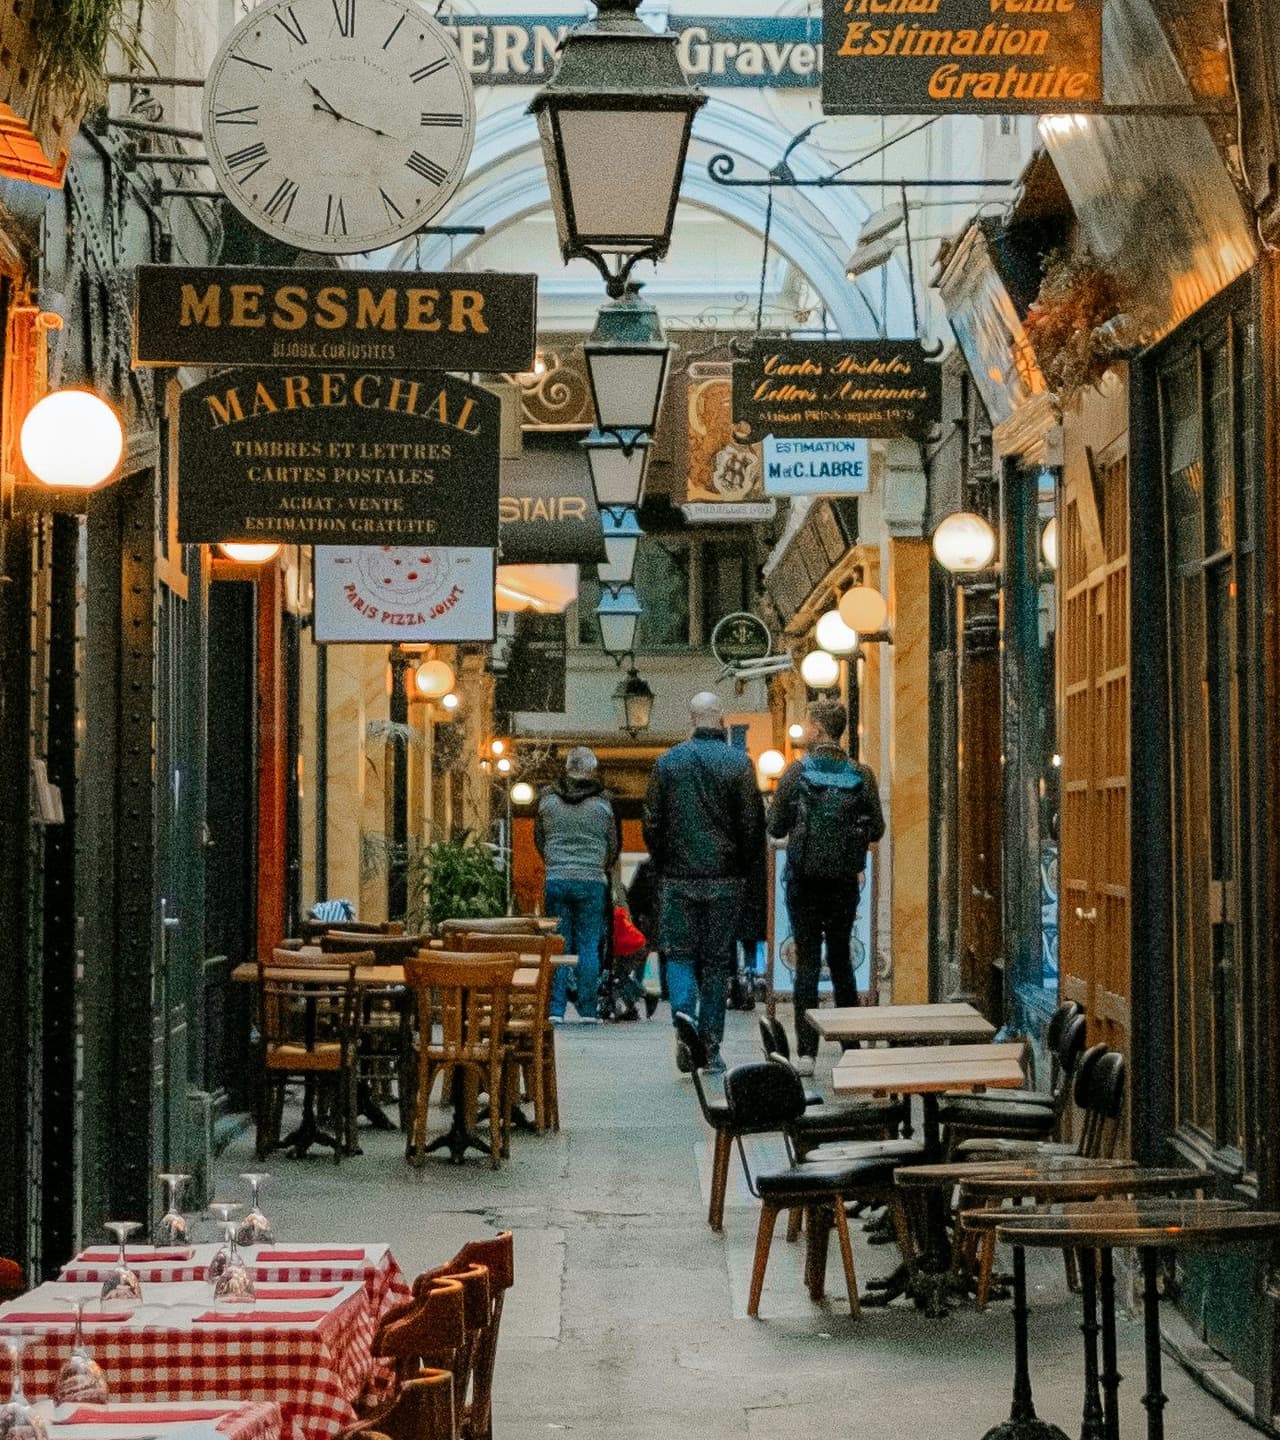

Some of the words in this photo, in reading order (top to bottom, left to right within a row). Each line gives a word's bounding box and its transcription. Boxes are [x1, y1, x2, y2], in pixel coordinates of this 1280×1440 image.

[836, 20, 1051, 57] Estimation
[926, 62, 1092, 101] Gratuite
[179, 283, 490, 334] MESSMER
[205, 372, 483, 438] MARECHAL
[231, 440, 322, 458] TIMBRES
[326, 441, 356, 458] ET
[359, 441, 453, 459] LETTRES
[775, 441, 857, 454] ESTIMATION
[247, 466, 327, 484] CARTES
[334, 466, 436, 486] POSTALES
[278, 496, 334, 511] ACHAT
[347, 496, 405, 512] VENTE
[244, 516, 347, 533] ESTIMATION
[351, 517, 437, 534] GRATUITE
[343, 581, 379, 622] PARIS
[380, 610, 427, 627] PIZZA
[429, 583, 466, 621] JOINT
